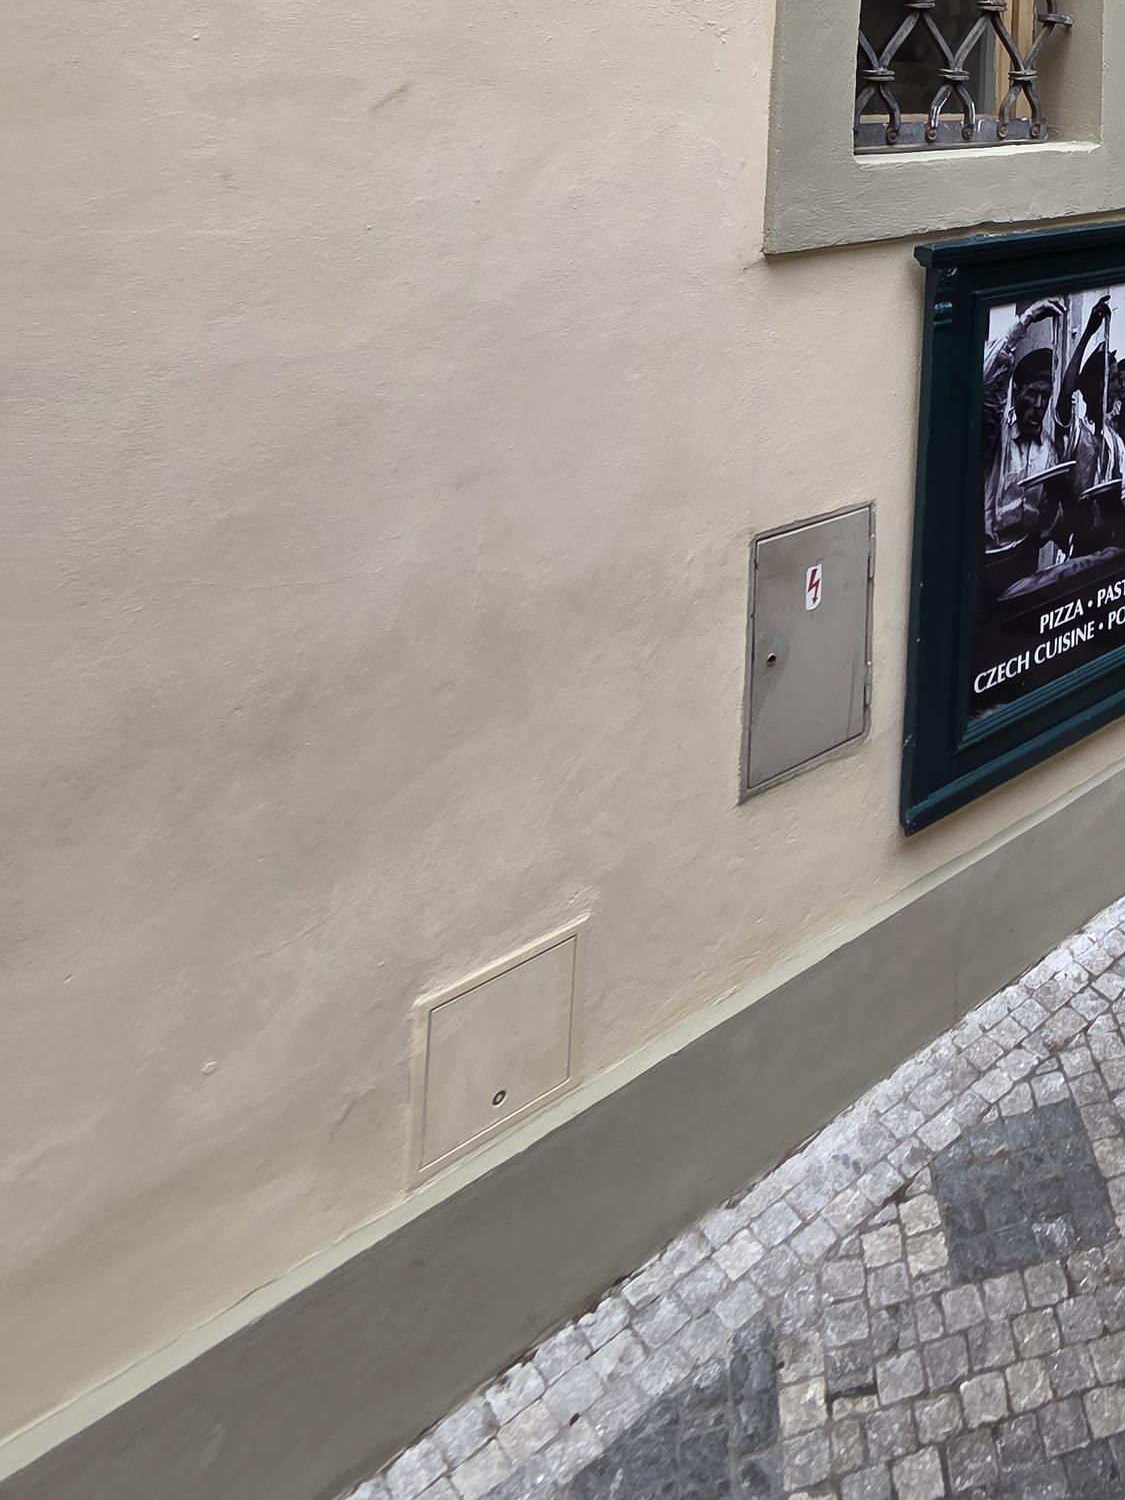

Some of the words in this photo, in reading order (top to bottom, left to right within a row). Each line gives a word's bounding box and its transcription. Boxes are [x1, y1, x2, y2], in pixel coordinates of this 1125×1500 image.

[1039, 599, 1084, 634] PIZZA
[973, 654, 1030, 694] CZECH
[1034, 621, 1095, 664] CUISINE
